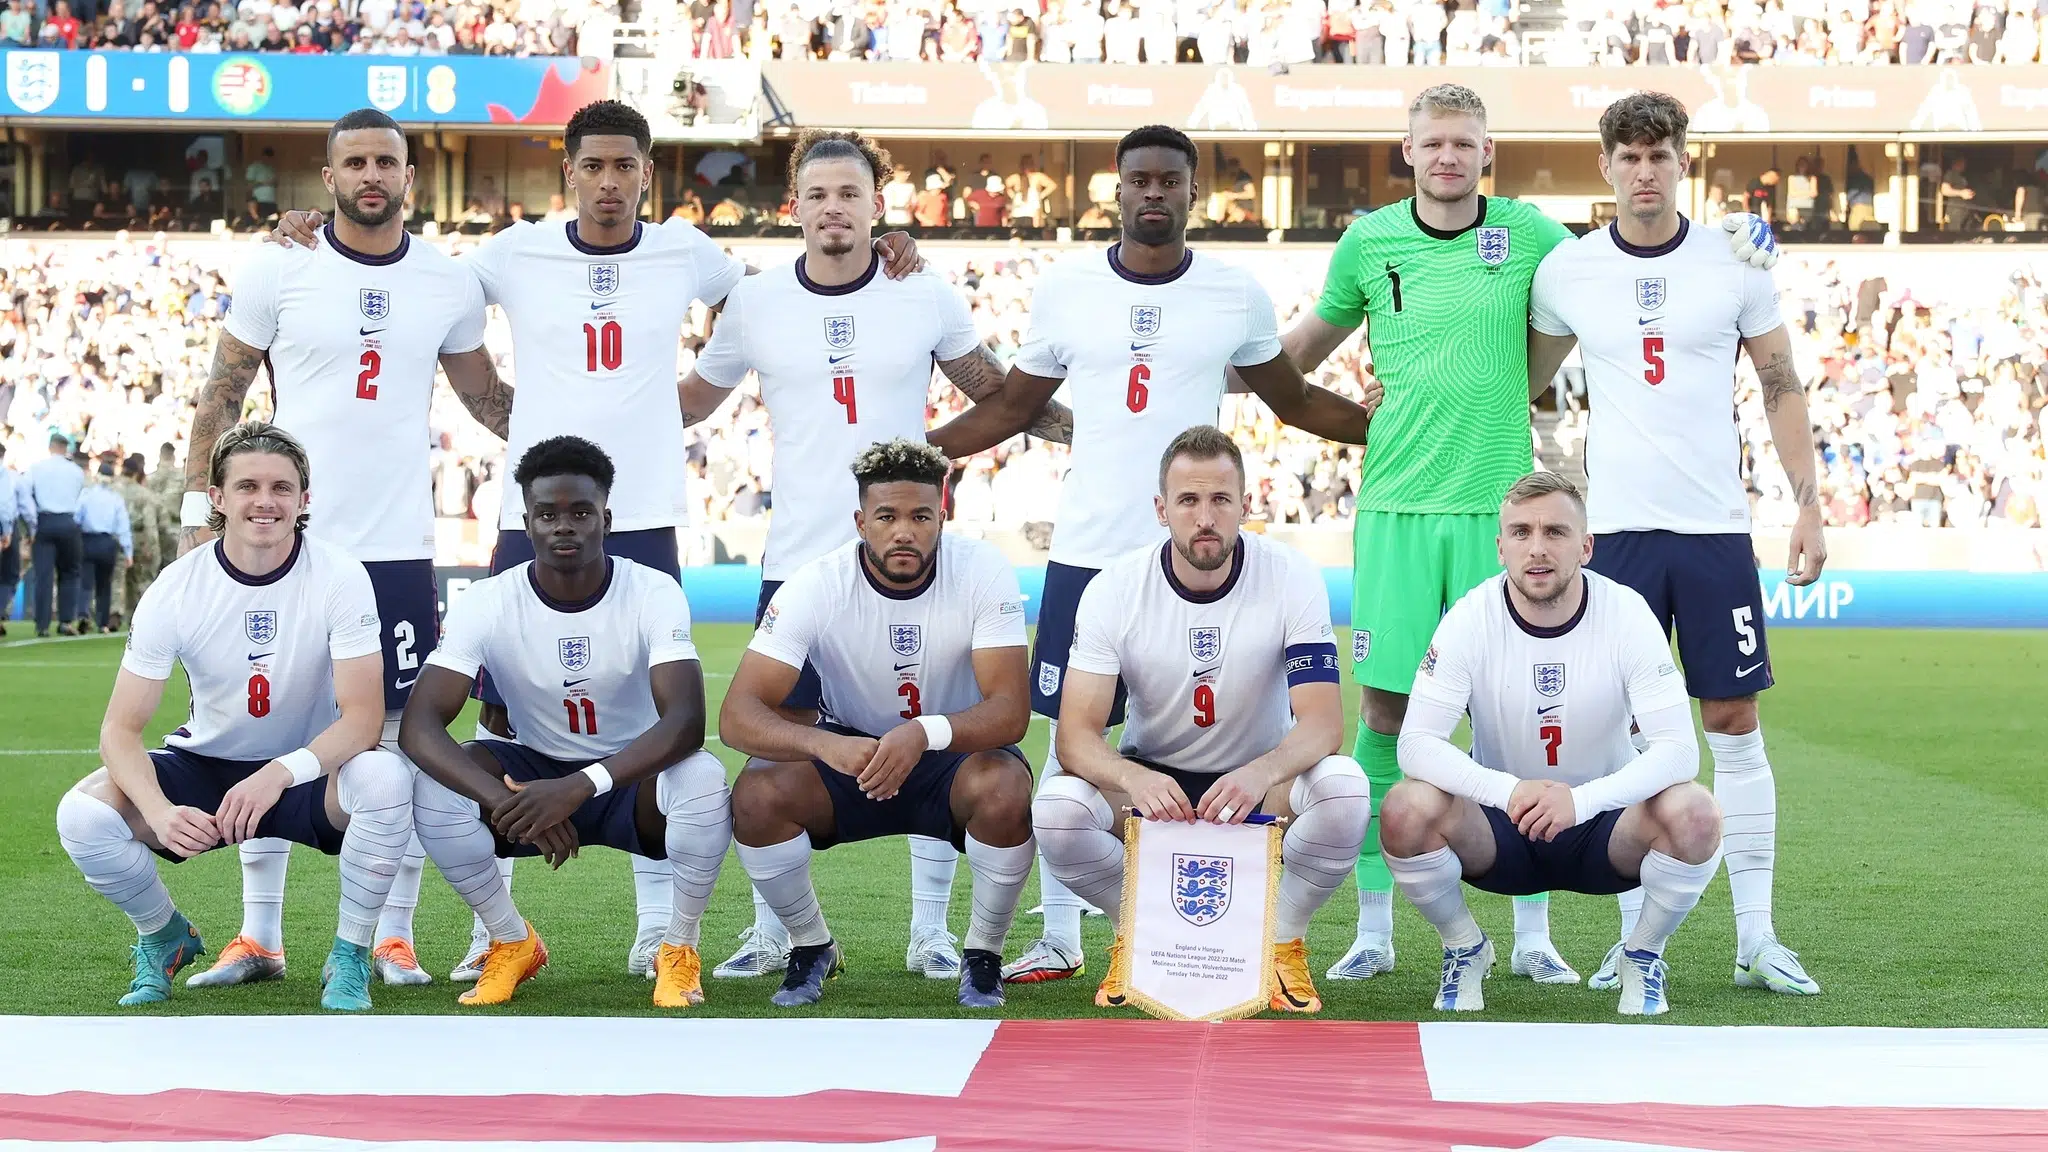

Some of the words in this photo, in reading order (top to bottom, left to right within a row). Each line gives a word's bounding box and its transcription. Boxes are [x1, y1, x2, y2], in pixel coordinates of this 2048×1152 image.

[1387, 270, 1402, 313] 1
[583, 321, 622, 371] 10
[1643, 338, 1664, 386] 5
[356, 350, 381, 400] 2
[1126, 364, 1150, 413] 6
[833, 377, 858, 424] 4
[1760, 581, 1854, 620] МИР
[394, 620, 418, 670] 2
[1732, 605, 1757, 656] 5
[248, 674, 270, 718] 8
[563, 698, 597, 735] 11
[898, 682, 922, 719] 3
[1194, 685, 1215, 727] 9
[1540, 726, 1562, 766] 7
[1167, 952, 1187, 960] Nations
[1188, 953, 1207, 962] League
[1208, 955, 1229, 963] 2022/23
[1176, 944, 1196, 952] England
[1202, 946, 1225, 955] Hungary
[1178, 962, 1201, 970] Stadium,
[1202, 964, 1244, 973] Wolverhampton
[1167, 970, 1187, 978] Tuesday
